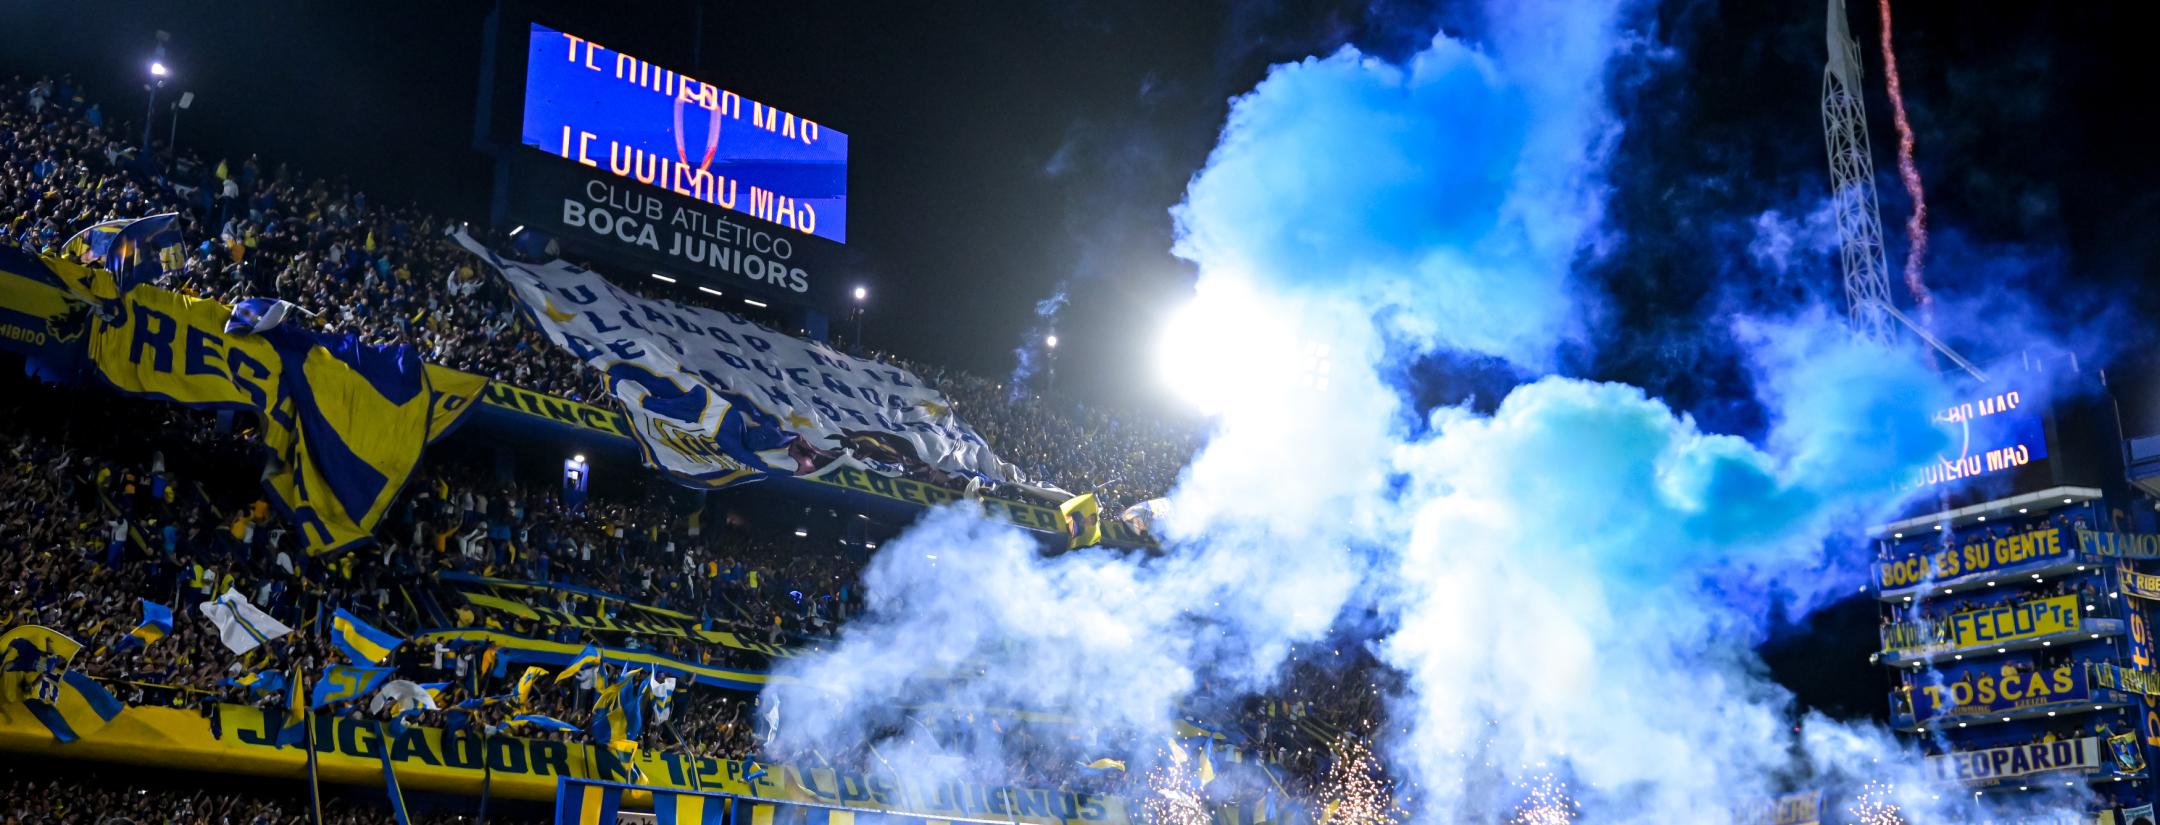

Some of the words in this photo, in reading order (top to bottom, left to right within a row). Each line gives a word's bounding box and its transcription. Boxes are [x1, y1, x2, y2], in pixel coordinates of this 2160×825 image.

[563, 199, 659, 250] BOCA
[669, 232, 808, 293] JUNIORS
[586, 180, 663, 221] CLUB
[671, 206, 792, 259] ATLÉTICO
[1881, 554, 1931, 587] BOCA
[1935, 550, 1959, 578] ES
[1964, 541, 1991, 572] SU
[1995, 528, 2060, 563] GENTE
[1923, 666, 2074, 709] TOSCAS
[237, 708, 570, 778] JUGADOR
[1934, 739, 2085, 781] LEOPARDI
